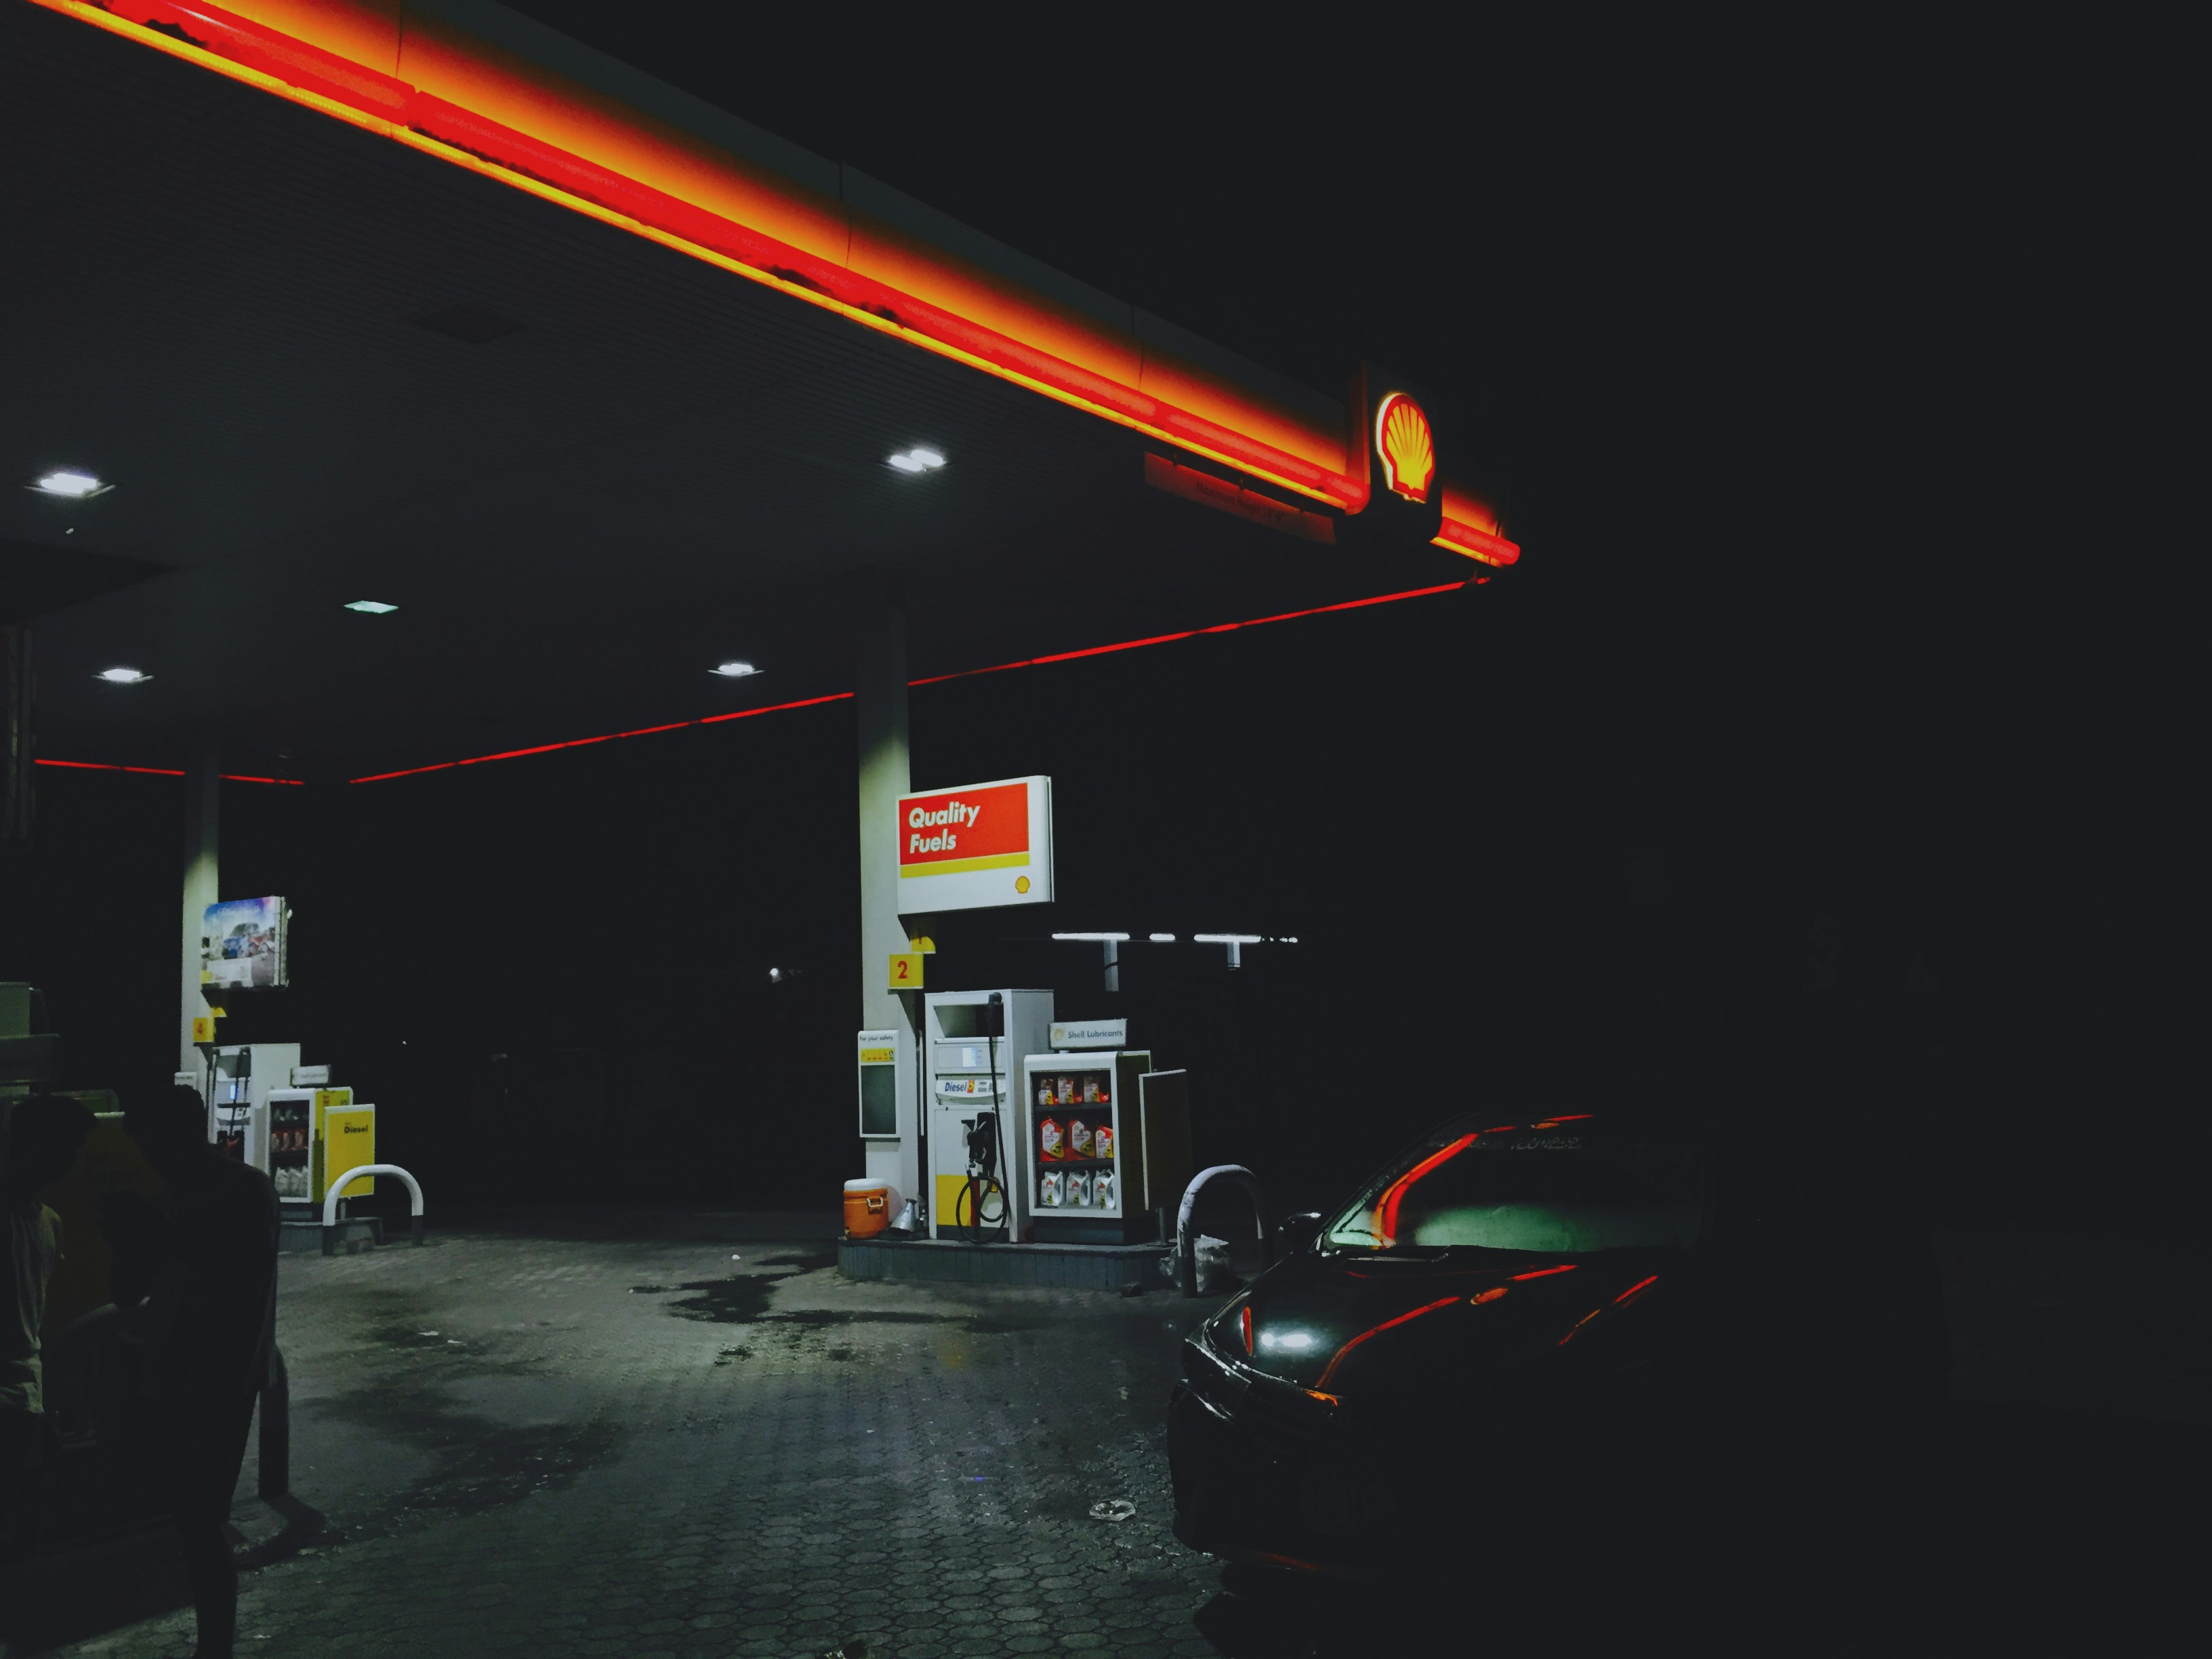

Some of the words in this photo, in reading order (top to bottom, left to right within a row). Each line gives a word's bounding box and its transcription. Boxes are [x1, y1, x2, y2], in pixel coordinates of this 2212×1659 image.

[909, 801, 981, 828] Quality
[909, 829, 957, 854] Fuels
[897, 960, 907, 979] 2
[1068, 1030, 1085, 1038] Shell
[1087, 1029, 1123, 1038] Lubricants
[945, 1082, 967, 1092] Diesel
[344, 1124, 369, 1134] Diesel
